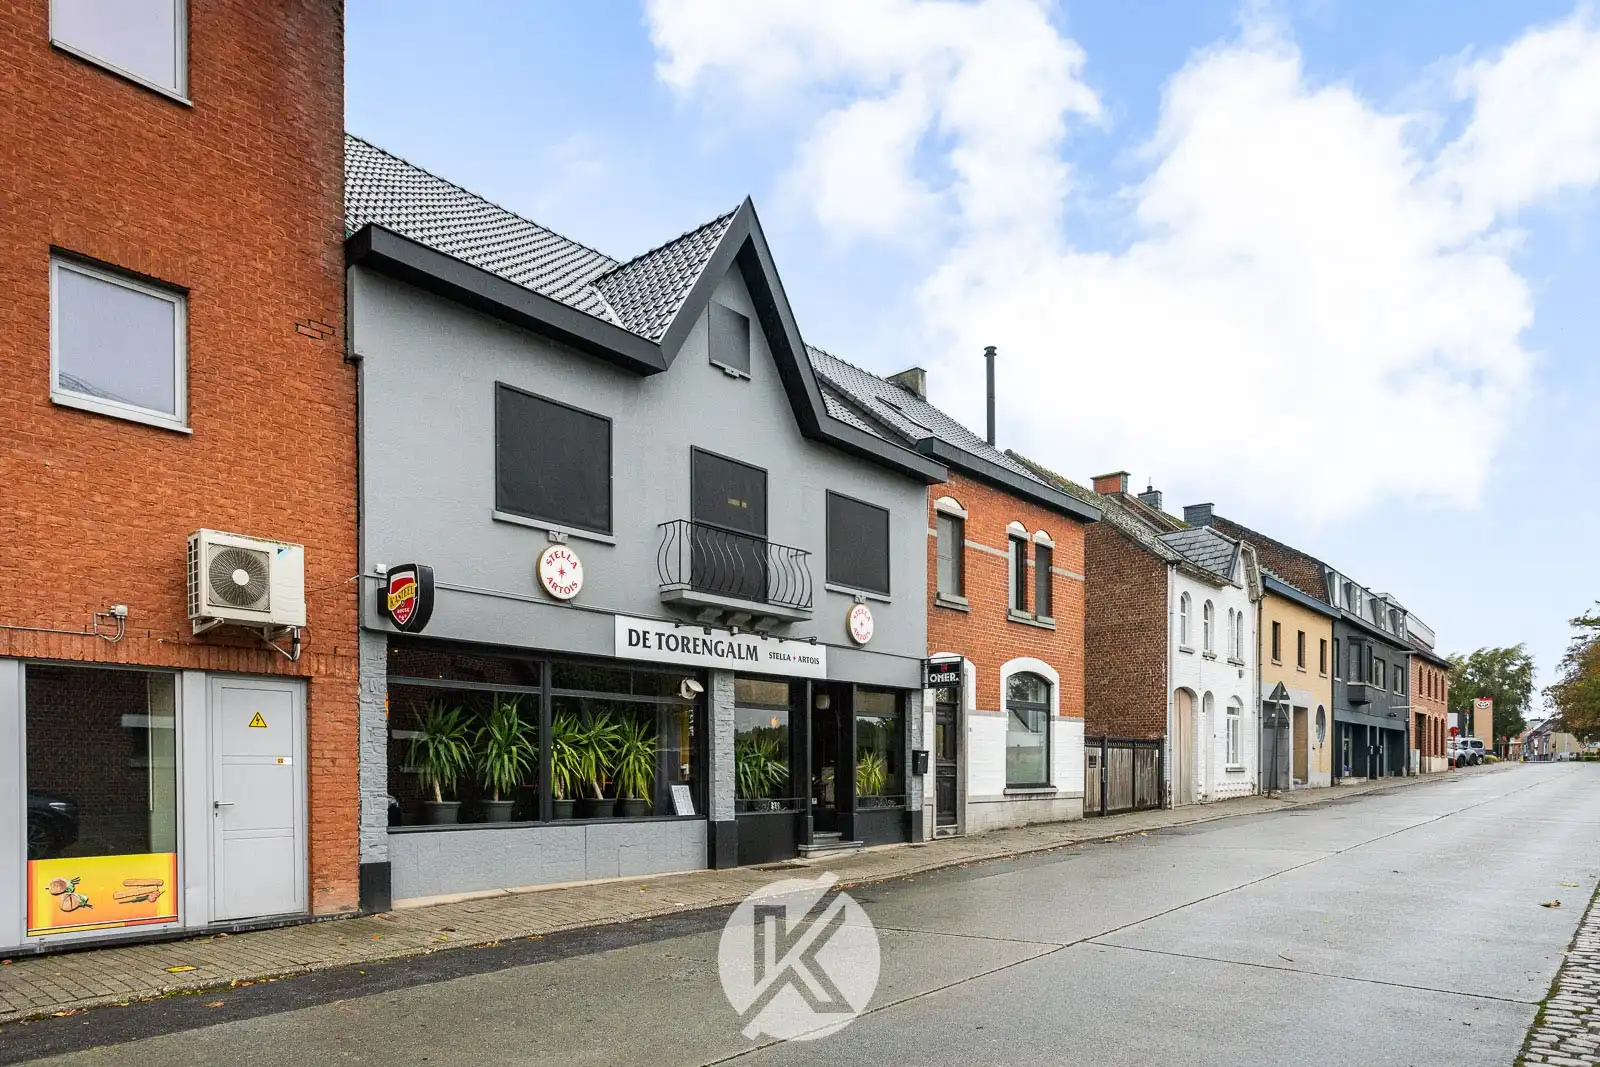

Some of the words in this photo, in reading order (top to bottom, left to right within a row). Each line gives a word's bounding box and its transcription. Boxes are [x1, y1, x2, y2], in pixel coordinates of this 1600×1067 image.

[546, 551, 577, 569] STELLA
[547, 577, 577, 594] ARTOIS
[389, 585, 414, 607] KASTEEL
[628, 628, 651, 649] DE
[655, 632, 759, 662] TORENGALM
[768, 651, 791, 662] STELLA
[797, 655, 820, 665] ARTOIS
